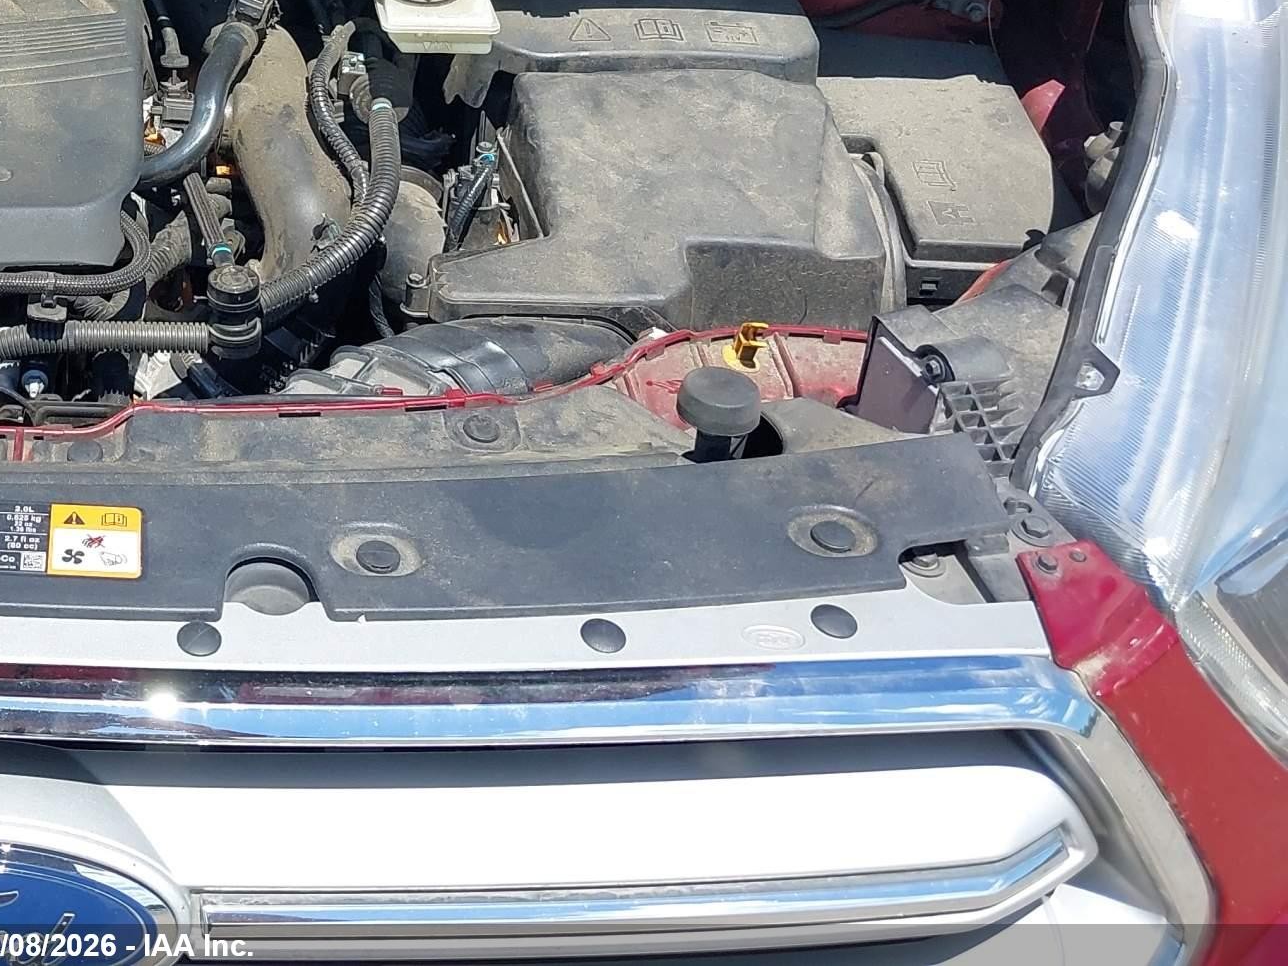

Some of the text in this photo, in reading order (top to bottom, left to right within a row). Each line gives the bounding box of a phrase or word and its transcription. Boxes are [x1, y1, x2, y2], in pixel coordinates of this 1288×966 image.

[30, 515, 42, 523] kg
[4, 535, 19, 543] 2.7
[23, 543, 38, 551] cc)
